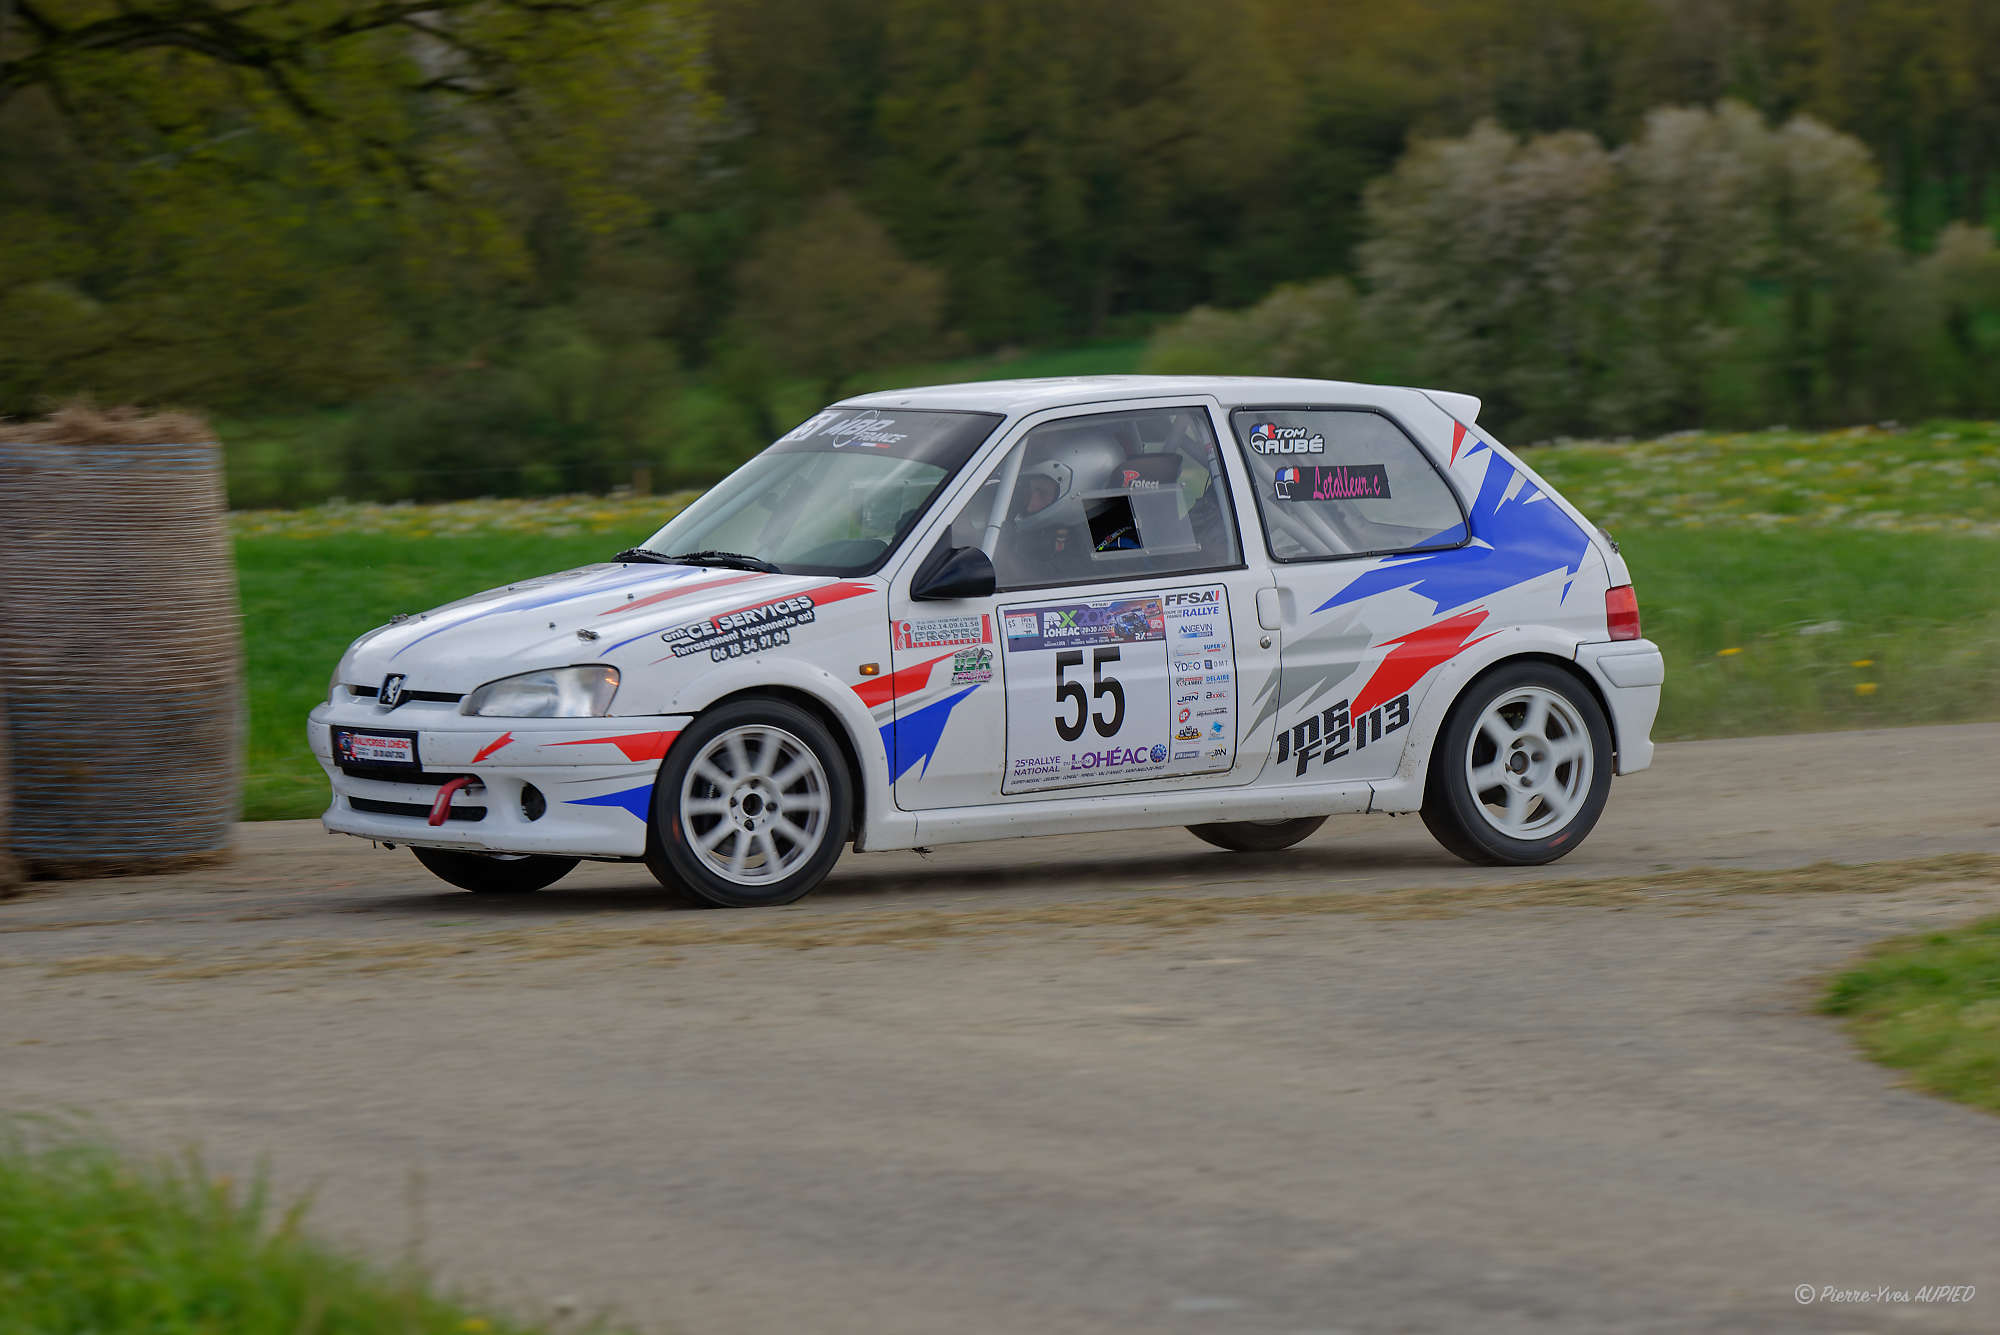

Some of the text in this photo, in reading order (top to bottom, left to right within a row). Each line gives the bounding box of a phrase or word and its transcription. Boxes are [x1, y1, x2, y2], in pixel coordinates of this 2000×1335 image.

[1274, 427, 1306, 439] TOM
[1264, 434, 1324, 454] AUBÉ
[1165, 591, 1214, 606] FFSA
[718, 595, 813, 631] SERVICES
[1182, 606, 1219, 617] RALLYE
[1044, 627, 1081, 637] LOHEAC
[672, 629, 740, 656] Terrassement
[712, 630, 789, 662] 06 18 34 91 94
[1055, 645, 1125, 742] 55
[1028, 755, 1061, 767] RALLYE
[1071, 746, 1148, 771] LOHÉAC
[1013, 765, 1060, 776] NATIONAL
